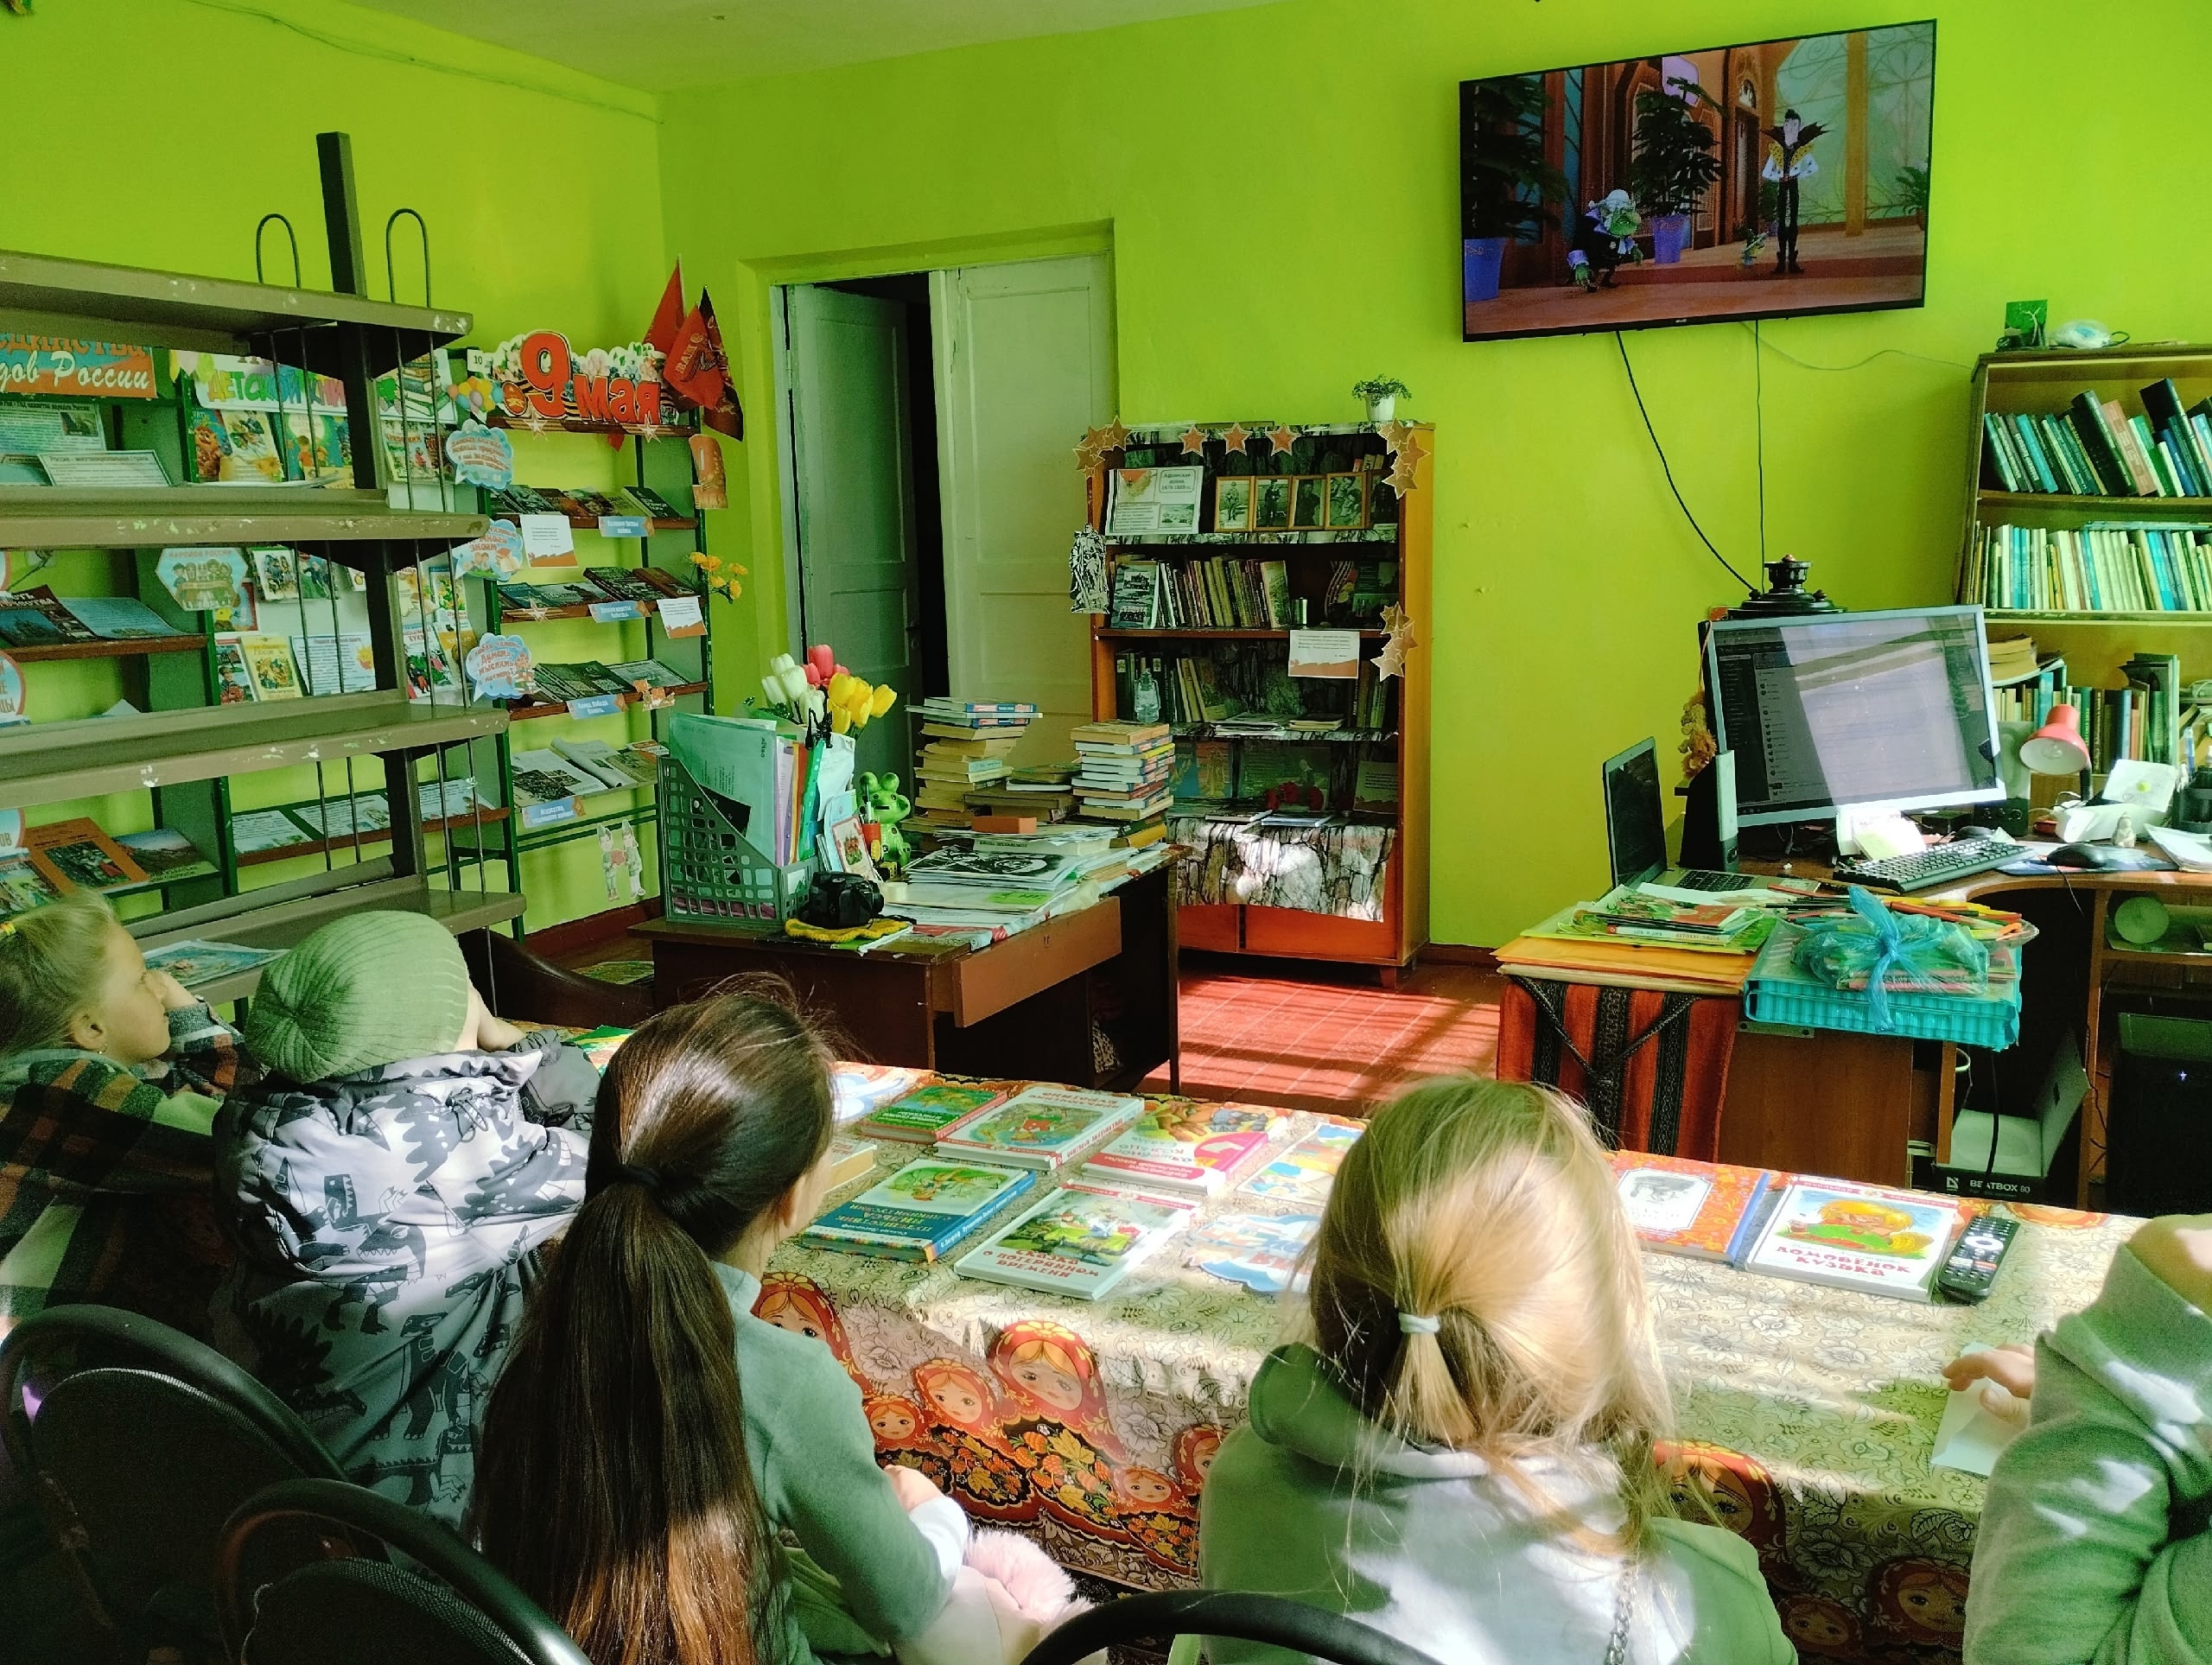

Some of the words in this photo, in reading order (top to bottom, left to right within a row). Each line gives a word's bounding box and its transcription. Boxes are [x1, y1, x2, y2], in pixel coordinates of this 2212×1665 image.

[50, 350, 150, 390] России
[474, 355, 483, 365] 10
[207, 365, 302, 404] ДЕТСКОЙ
[520, 330, 571, 418] 9
[995, 1259, 1072, 1278] ВРЕМЕНИ
[996, 1251, 1100, 1277] ПОТЕРЯННОМ
[1015, 1248, 1079, 1266] СКАЗКА
[1776, 1245, 1911, 1274] ДОМОВЁНОК
[1795, 1255, 1886, 1277] КУЗЬКА
